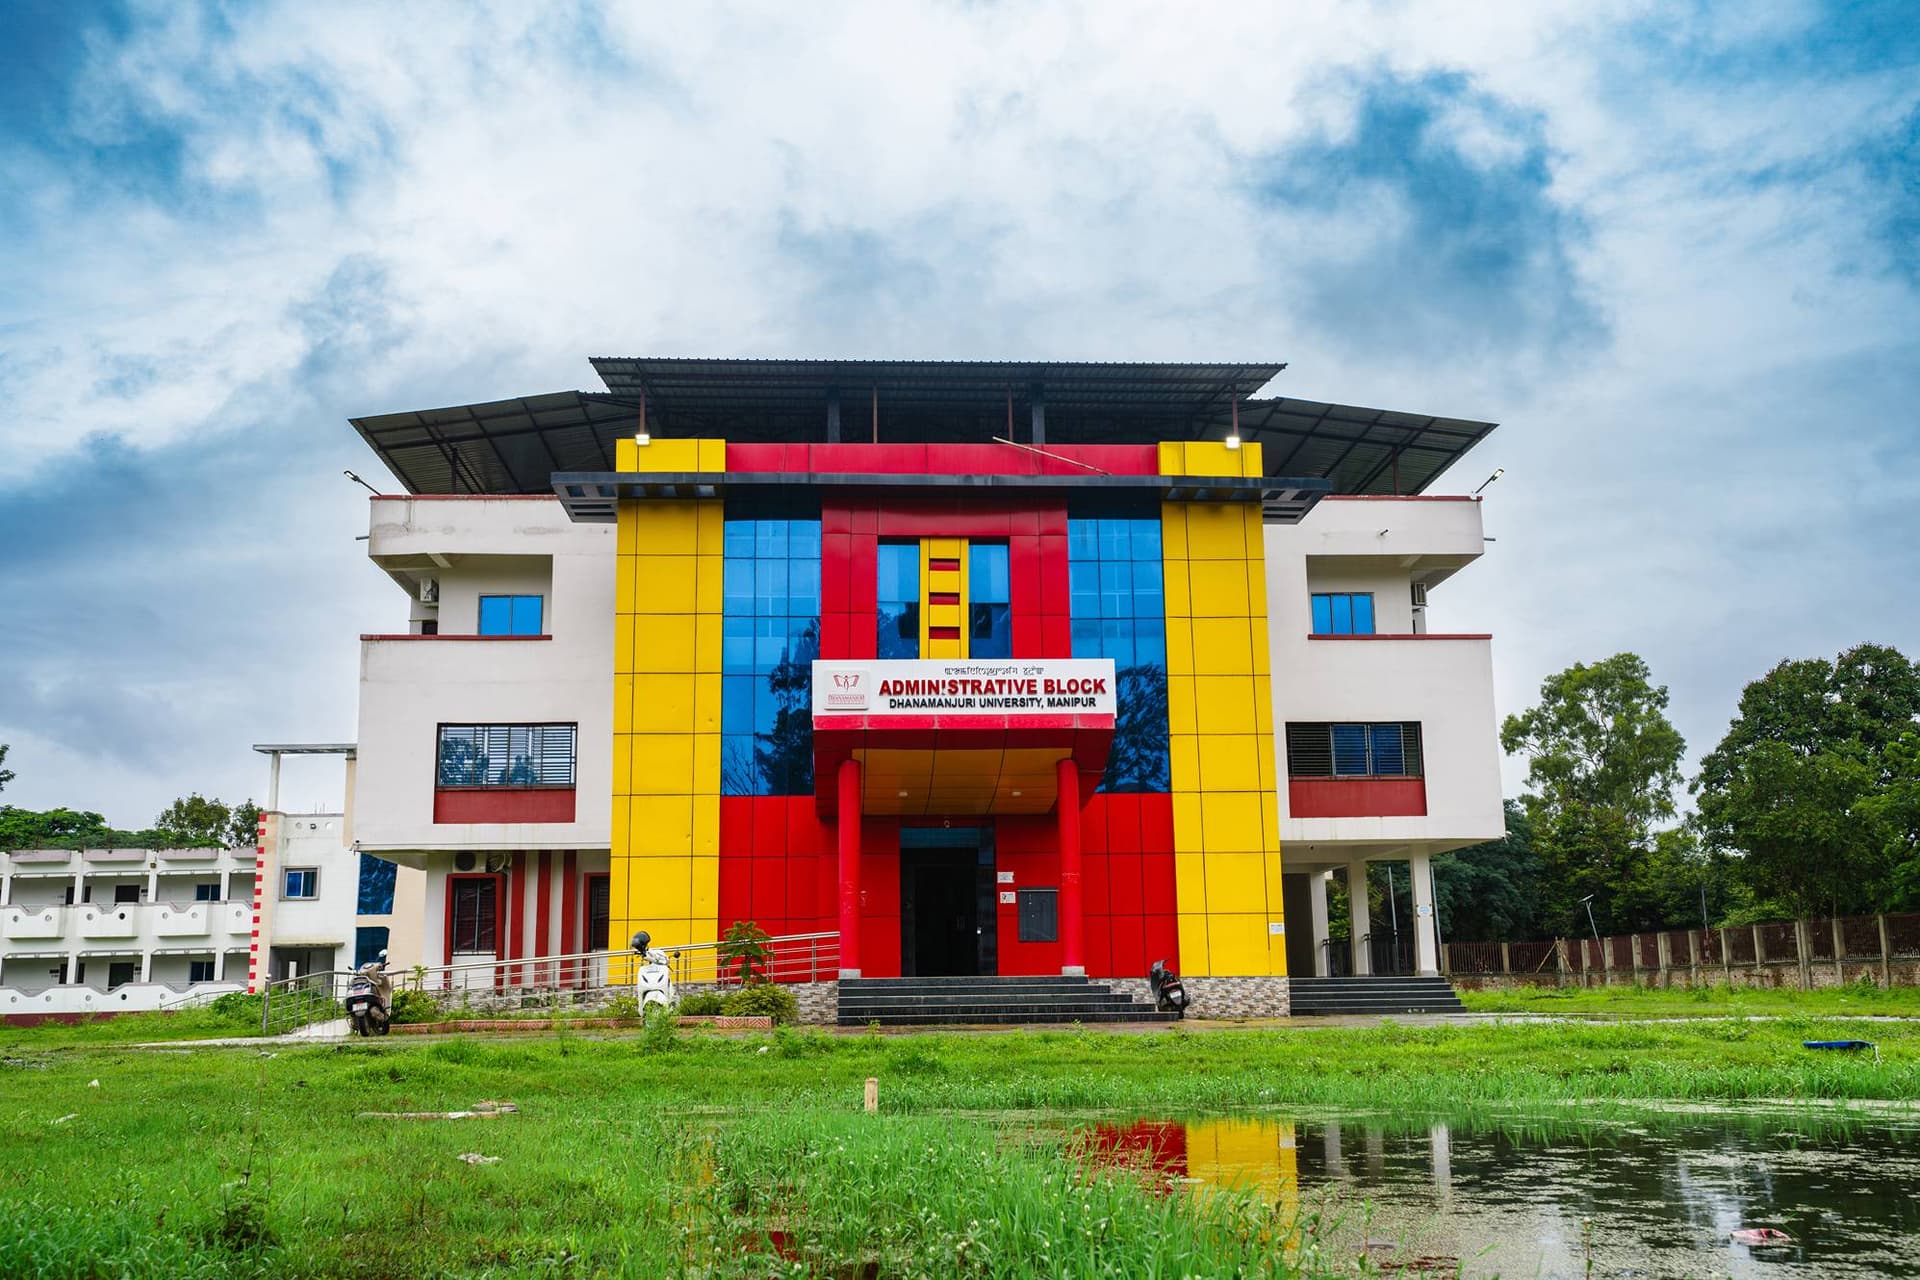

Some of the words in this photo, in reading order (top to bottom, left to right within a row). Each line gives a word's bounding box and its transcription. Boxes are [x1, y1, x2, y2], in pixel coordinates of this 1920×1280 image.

[1043, 678, 1107, 695] BLOCK
[889, 698, 976, 709] DHANAMANJURI
[979, 697, 1044, 709] UNIVERSITY,
[1047, 697, 1097, 708] MANIPUR
